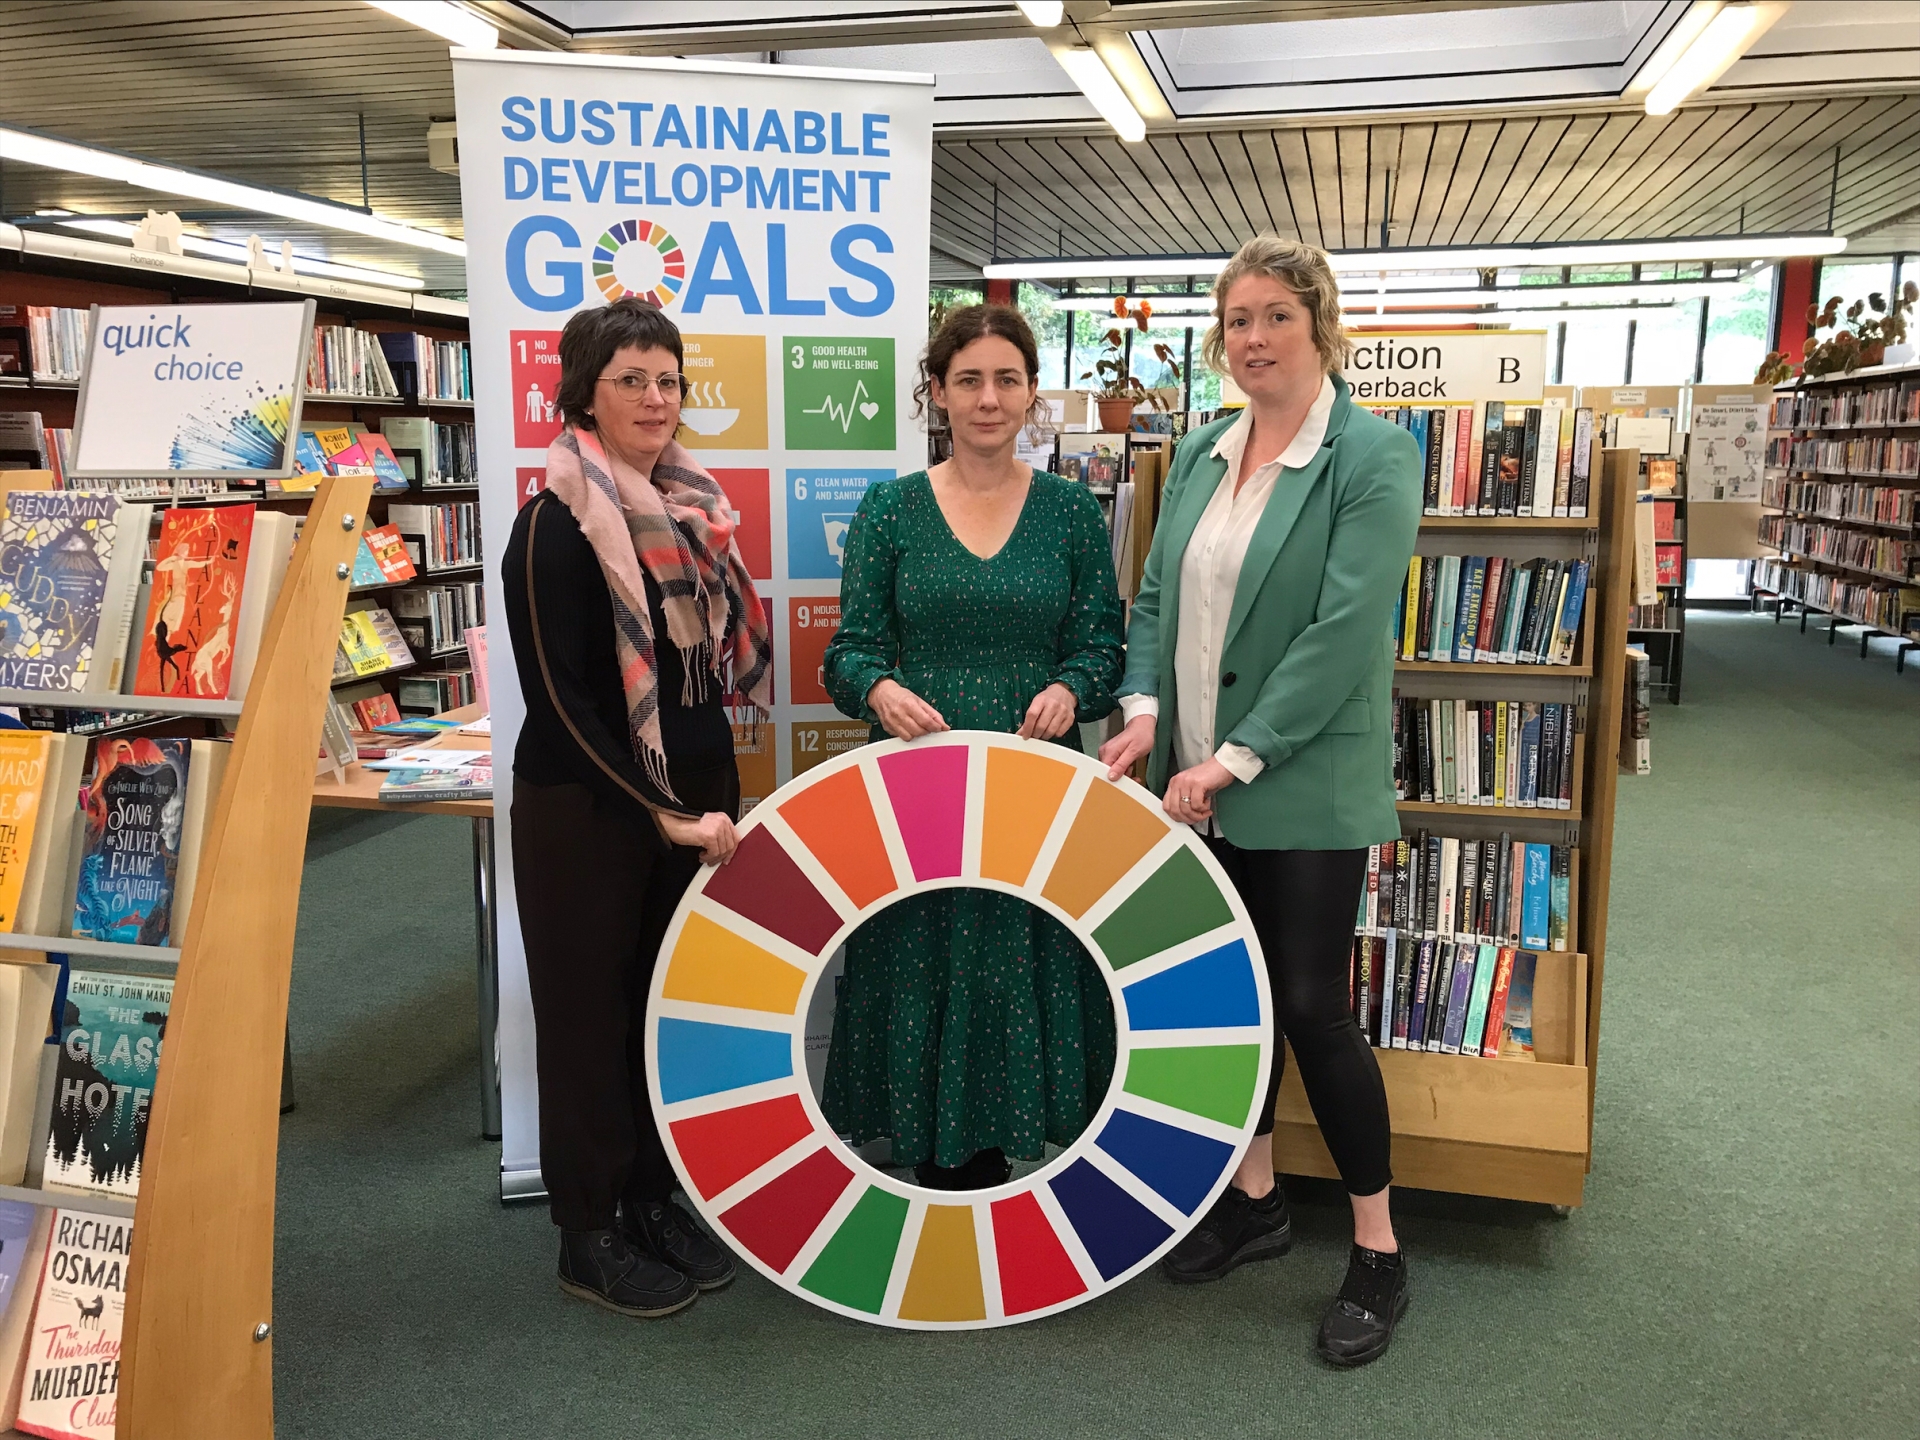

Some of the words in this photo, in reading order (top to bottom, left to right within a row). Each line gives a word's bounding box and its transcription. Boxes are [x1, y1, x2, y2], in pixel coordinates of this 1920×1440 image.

[501, 96, 890, 157] SUSTAINABLE
[504, 156, 890, 212] DEVELOPMENT
[130, 253, 164, 267] Romance
[505, 214, 895, 318] GOALS
[329, 285, 347, 295] Fiction
[103, 314, 192, 356] quick
[517, 340, 527, 364] 1
[534, 340, 547, 350] NO
[535, 354, 562, 365] POVE
[682, 343, 700, 353] ERO
[791, 345, 804, 369] 3
[812, 346, 835, 356] GOOD
[837, 346, 867, 357] HEALTH
[1344, 339, 1442, 370] iction
[154, 352, 243, 381] choice
[812, 360, 829, 369] AND
[831, 360, 879, 370] WELL-BEING
[1497, 357, 1521, 384] B
[1348, 376, 1447, 398] erback
[323, 433, 348, 443] MONICA
[333, 442, 345, 450] ALI
[1458, 452, 1466, 474] HOME
[525, 477, 540, 497] 4
[794, 477, 808, 500] 6
[815, 478, 840, 487] CLEAN
[842, 478, 868, 487] WATER
[815, 491, 831, 500] AND
[833, 490, 866, 500] SANITAT
[14, 498, 109, 518] BENJAMIN
[1471, 568, 1484, 590] KATE
[0, 544, 93, 652] CUDDY
[797, 605, 810, 628] 9
[813, 605, 841, 615] INDUST
[813, 618, 829, 628] AND
[1466, 593, 1480, 637] ATKINSON
[797, 730, 819, 752] 12
[826, 729, 869, 739] RESPONSIBL
[1544, 707, 1555, 750] NIGHT
[826, 741, 868, 751] CONSUMPT
[1527, 744, 1538, 785] REGENCY
[434, 791, 459, 799] crafty
[460, 790, 473, 798] kid
[1396, 840, 1405, 867] BERRY
[1487, 843, 1496, 859] CITY
[109, 852, 154, 878] FLAME
[1369, 847, 1378, 889] HUNTED
[1429, 853, 1438, 882] DODGERS
[1463, 851, 1477, 887] BILLINGHAM
[1528, 850, 1543, 885] Binchy
[1484, 871, 1494, 900] JACKALS
[1394, 884, 1402, 922] EXCHANGE
[1361, 961, 1370, 982] BOX
[73, 982, 100, 996] EMILY
[103, 985, 115, 998] ST.
[119, 987, 143, 1000] JOHN
[145, 990, 171, 1003] MAND
[108, 1006, 141, 1025] THE
[60, 1078, 151, 1130] HOTE
[58, 1216, 133, 1256] RiCHA
[52, 1250, 129, 1293] OSMA
[45, 1328, 121, 1363] Thursday
